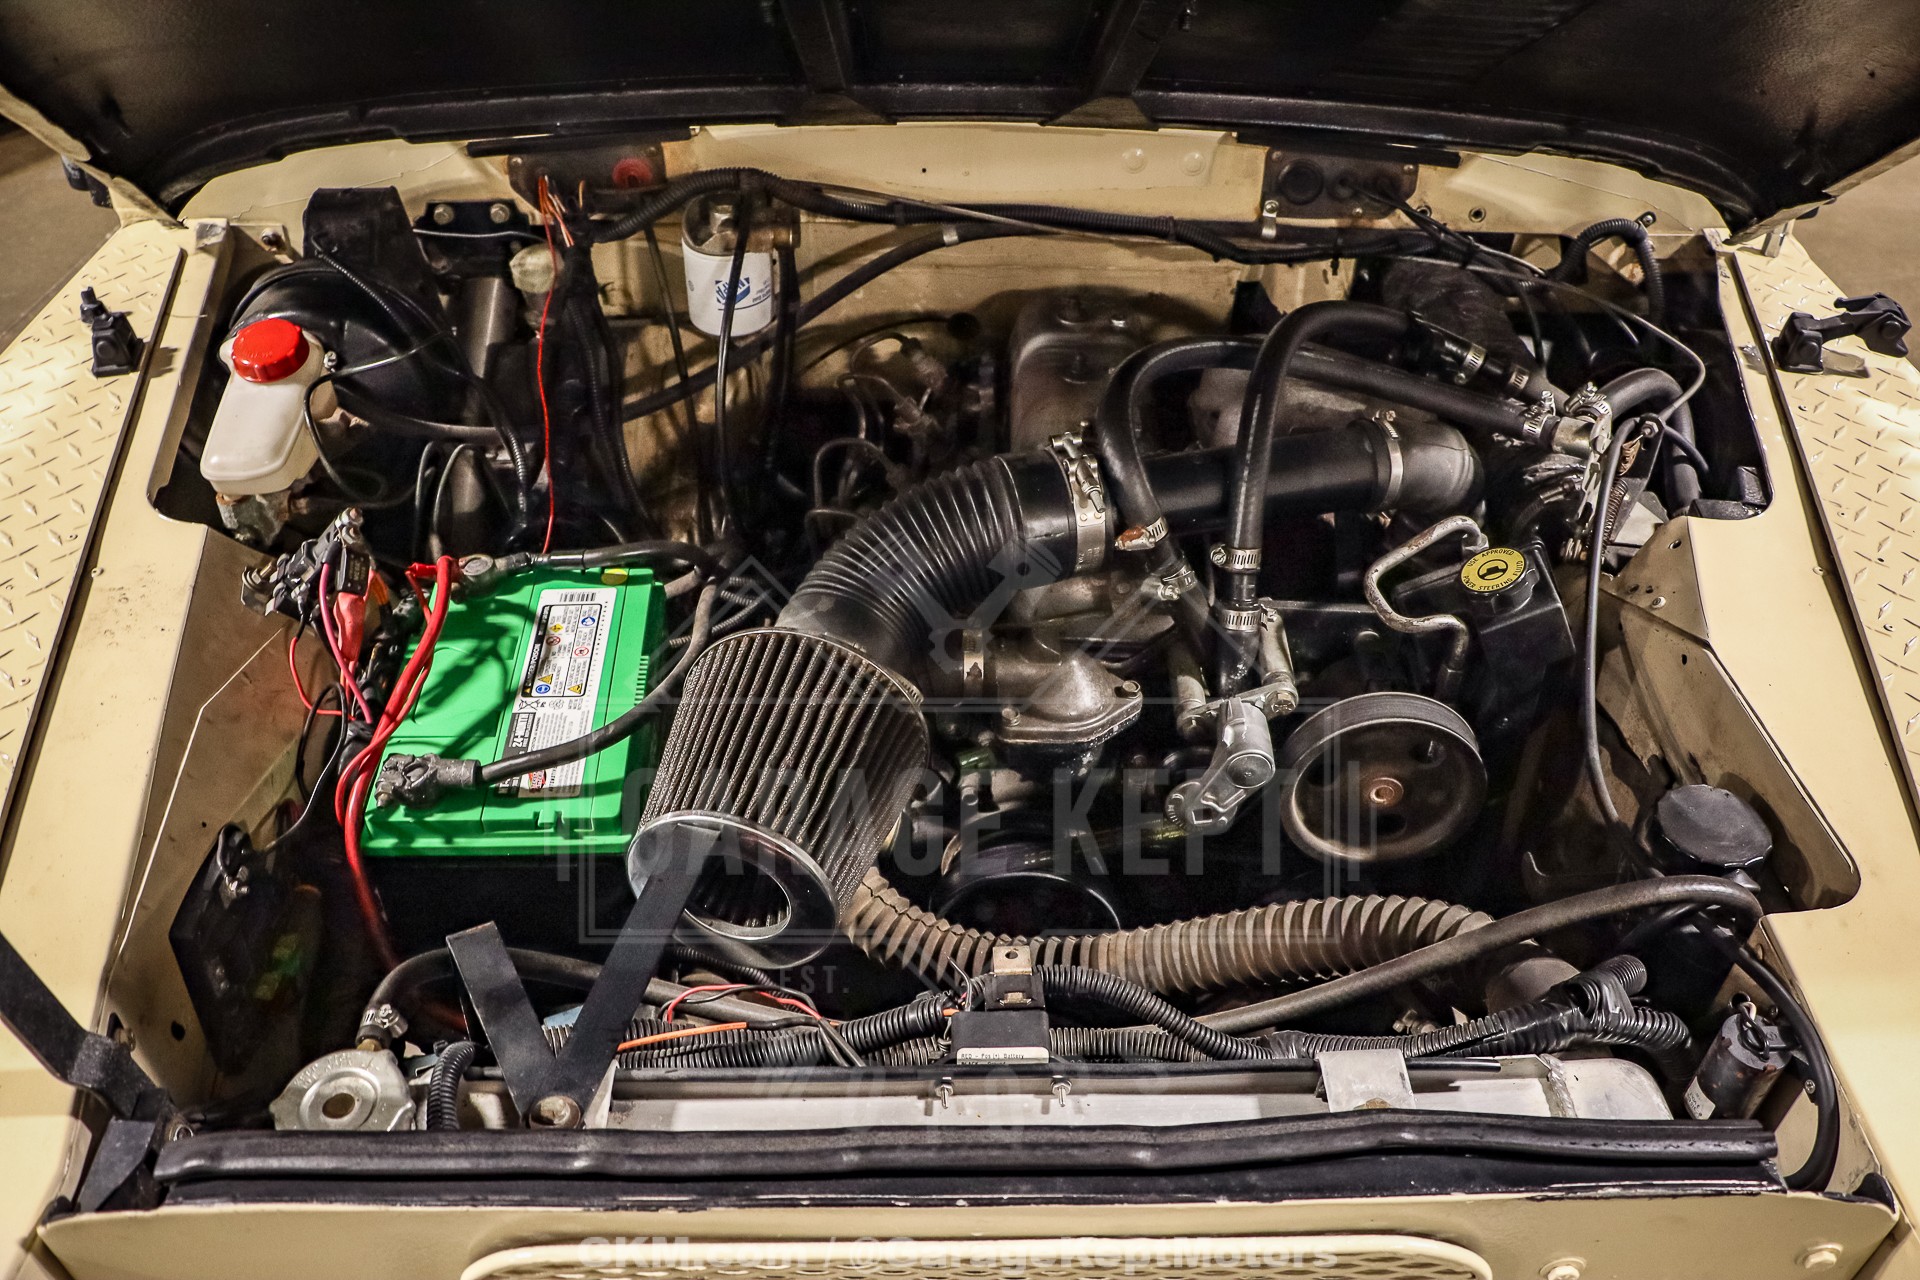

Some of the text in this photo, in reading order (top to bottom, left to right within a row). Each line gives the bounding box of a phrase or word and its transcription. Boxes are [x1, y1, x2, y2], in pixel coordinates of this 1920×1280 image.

[1467, 548, 1515, 568] USE APPROVED
[1463, 560, 1523, 591] POWER STEERING FLUID
